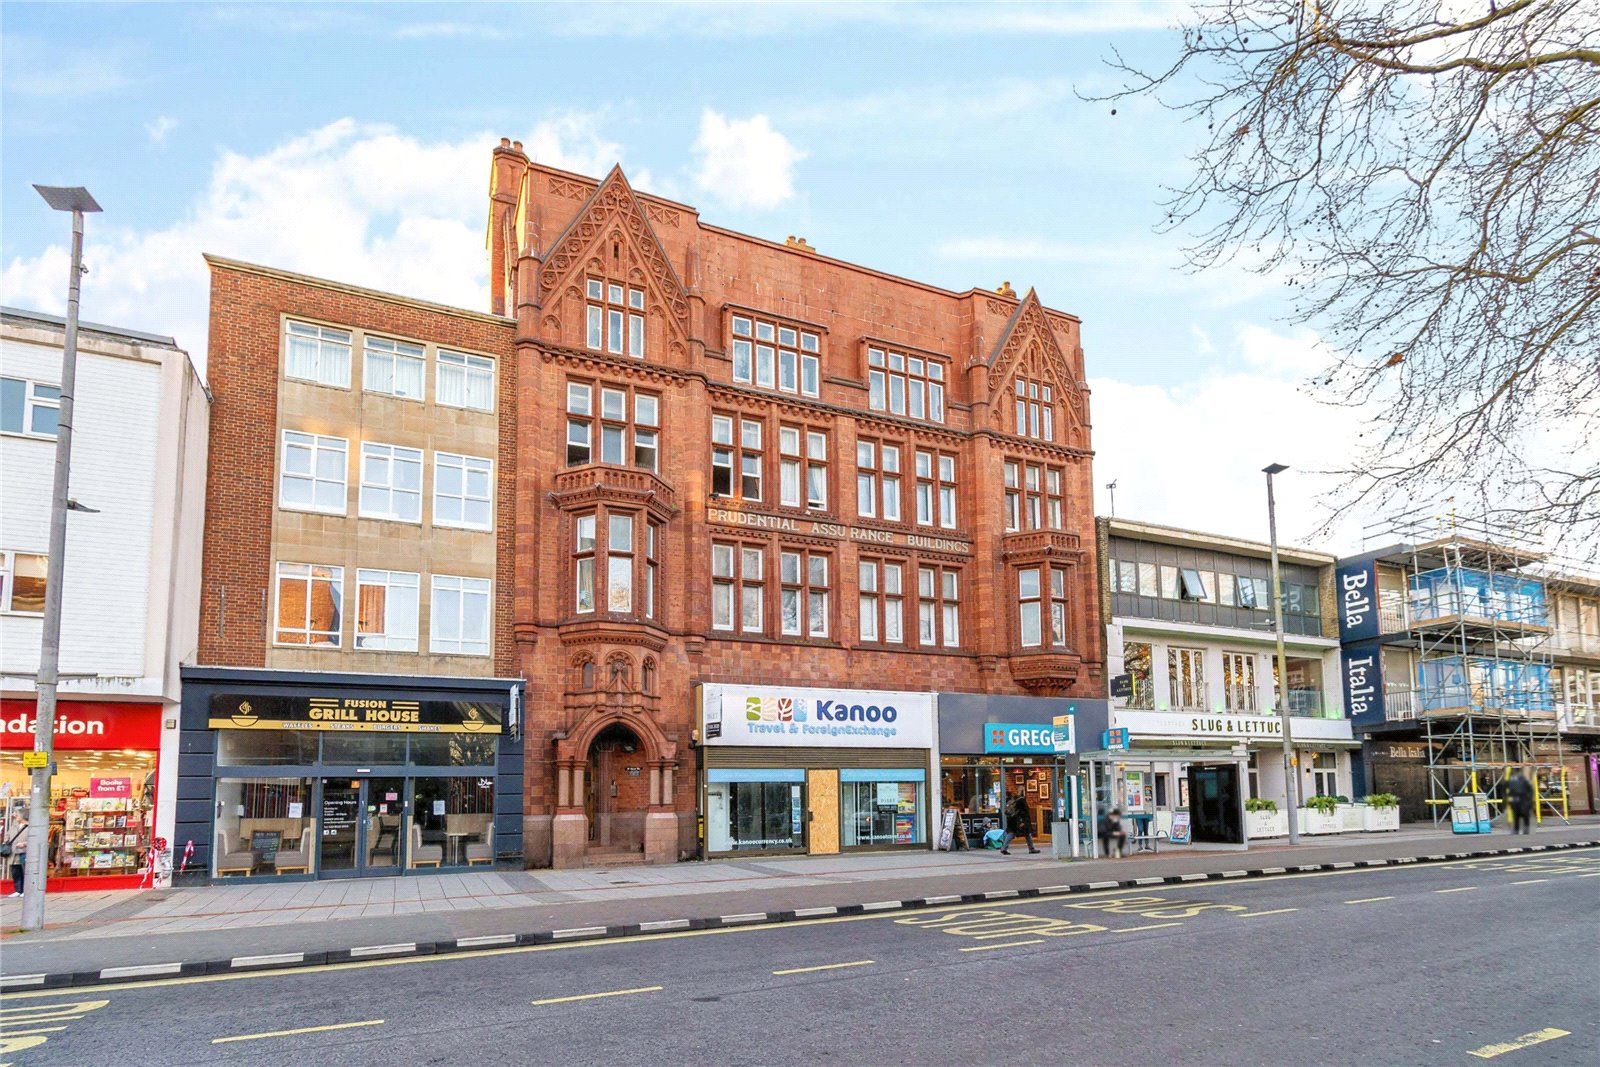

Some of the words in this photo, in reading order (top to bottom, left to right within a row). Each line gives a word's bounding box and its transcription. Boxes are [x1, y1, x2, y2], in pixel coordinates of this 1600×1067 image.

[708, 509, 800, 531] PRUDENTIAL
[907, 534, 969, 553] BUILDINGS
[1343, 570, 1370, 629] Bella
[1348, 656, 1375, 715] Italia
[309, 707, 358, 721] GRILL
[365, 709, 419, 722] HOUSE
[344, 699, 387, 709] FUSION
[816, 700, 897, 722] Kanoo
[0, 713, 104, 735] daion
[747, 723, 785, 734] Travel
[789, 724, 799, 734] &
[802, 724, 897, 738] ForeignExchange
[1192, 718, 1222, 731] SLUG
[1227, 719, 1233, 732] &
[1390, 746, 1407, 758] Bella
[1062, 896, 1248, 919] BUS
[893, 910, 1108, 939] STOP
